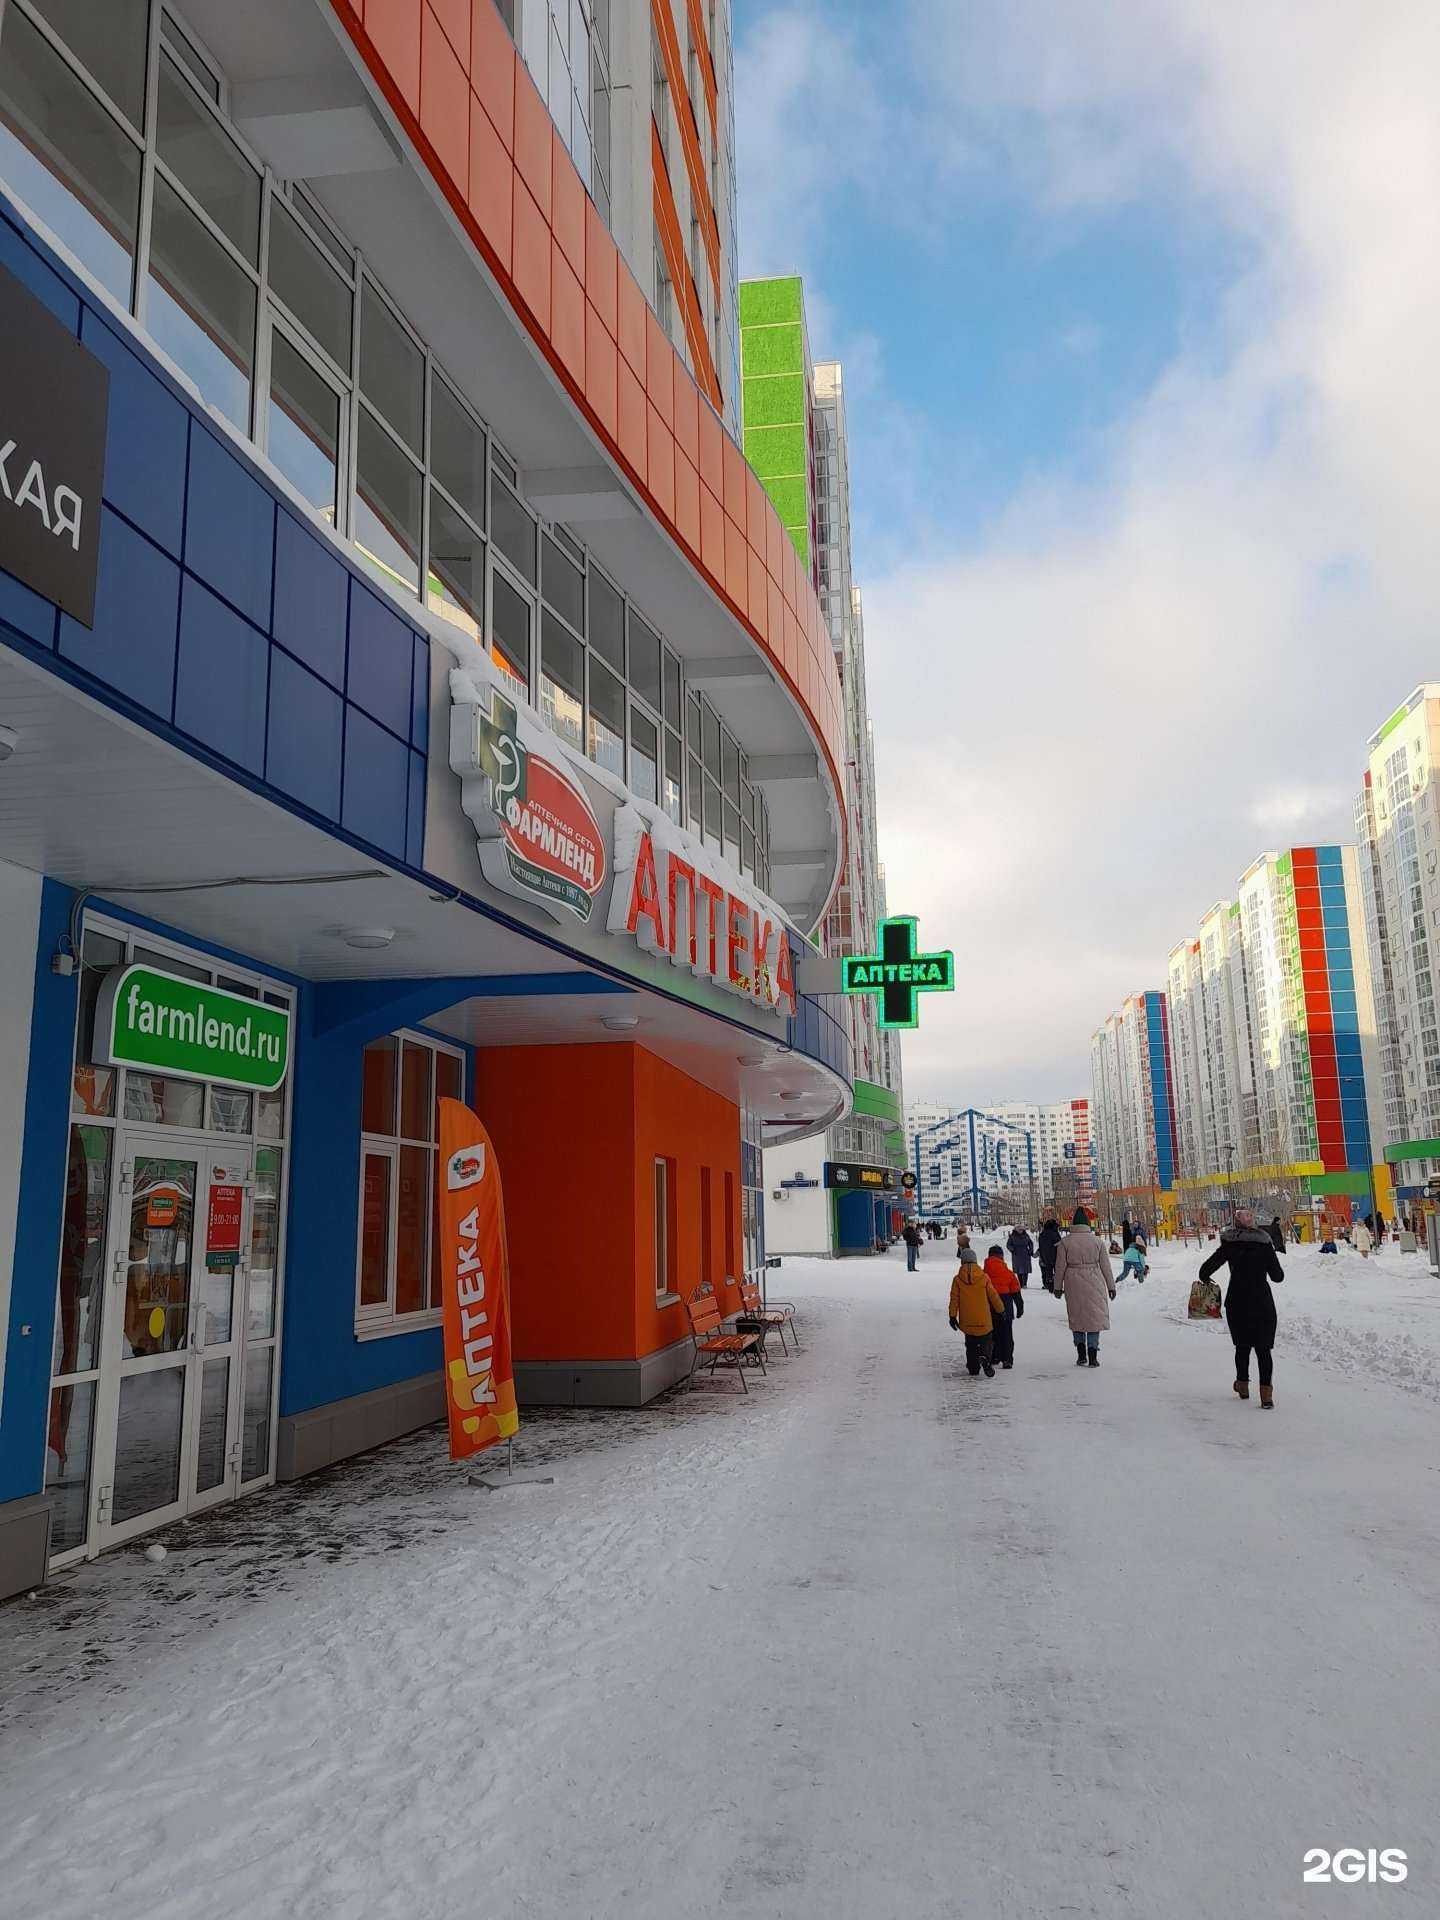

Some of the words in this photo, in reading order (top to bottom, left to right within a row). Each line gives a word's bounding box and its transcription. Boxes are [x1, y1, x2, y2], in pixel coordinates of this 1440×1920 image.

[506, 796, 595, 886] ФАРМЛЕНД
[528, 800, 574, 836] АПТЕЧНАЯ
[575, 831, 595, 851] СЕТЬ
[627, 831, 797, 1016] АПТЕКА
[853, 963, 943, 983] АПТЕКА
[128, 984, 279, 1062] farmlend.ru
[457, 1206, 497, 1404] АПТЕКА
